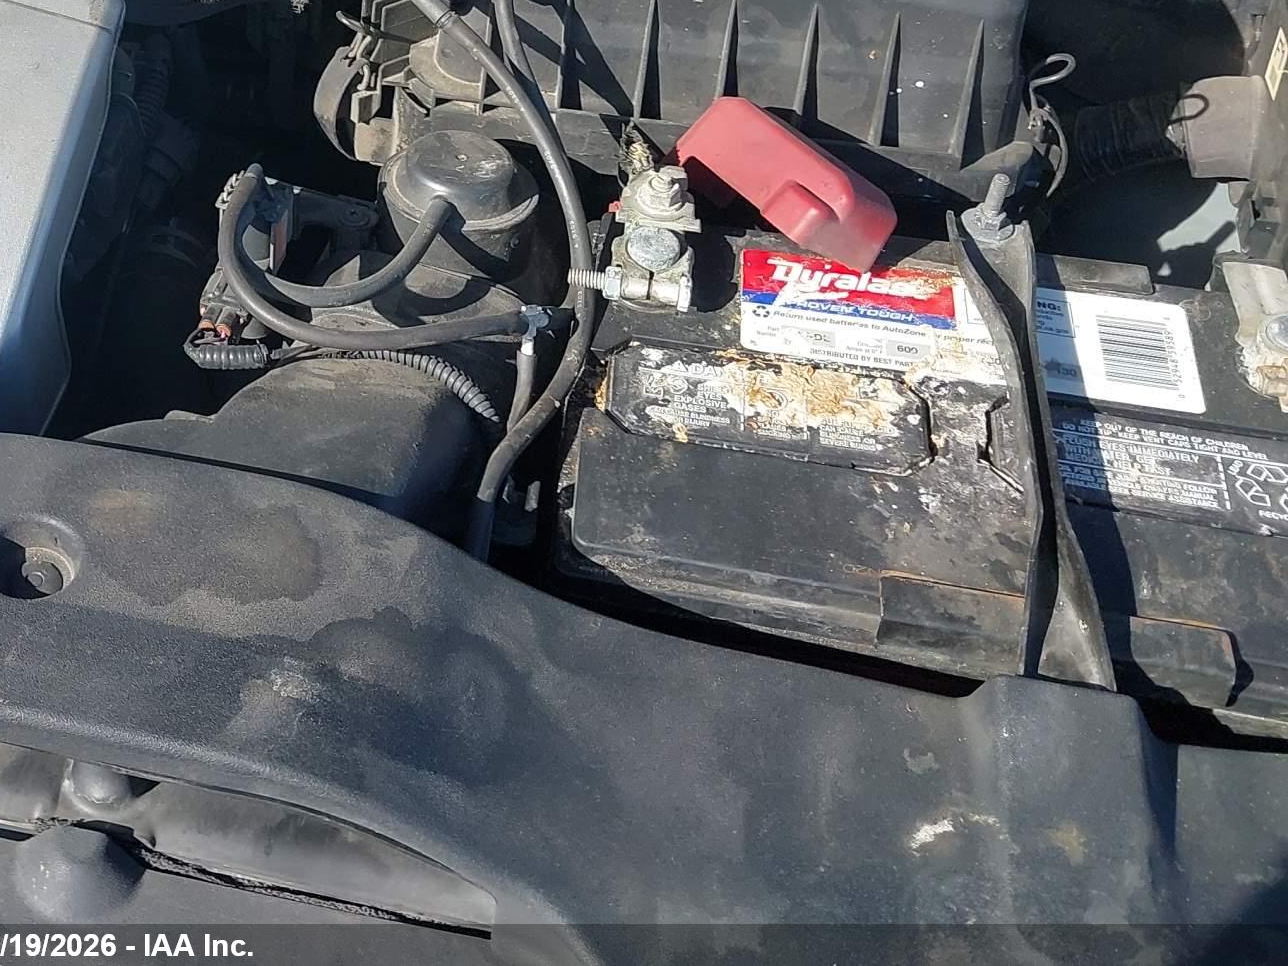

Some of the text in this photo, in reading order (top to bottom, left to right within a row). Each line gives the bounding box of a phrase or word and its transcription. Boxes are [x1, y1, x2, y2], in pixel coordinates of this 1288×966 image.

[767, 256, 922, 300] Duralas
[786, 300, 914, 322] PROVEN TOUGH
[806, 314, 829, 324] used
[871, 322, 881, 331] to
[882, 326, 927, 338] AutoZone
[860, 354, 872, 363] BY
[873, 356, 893, 365] BEST
[896, 344, 919, 355] 600
[674, 395, 728, 410] EXPLOSIVE
[698, 392, 723, 401] EYES
[673, 401, 708, 414] GASES
[1062, 422, 1076, 430] DO
[1078, 424, 1096, 433] NOT
[1117, 431, 1141, 442] KEEP
[1142, 435, 1165, 444] VENT
[1167, 439, 1192, 449] CAPS
[1193, 443, 1219, 453] TIGHT
[1221, 447, 1241, 456] AND
[1242, 451, 1269, 461] LEVEL
[1080, 419, 1250, 452] KEEP OUT OF THE REACH OF CHILDREN
[1063, 434, 1200, 464] FLUSH EYES IMMEDIATELY
[1066, 453, 1111, 467] MEDICAL
[1113, 459, 1143, 473] HELP
